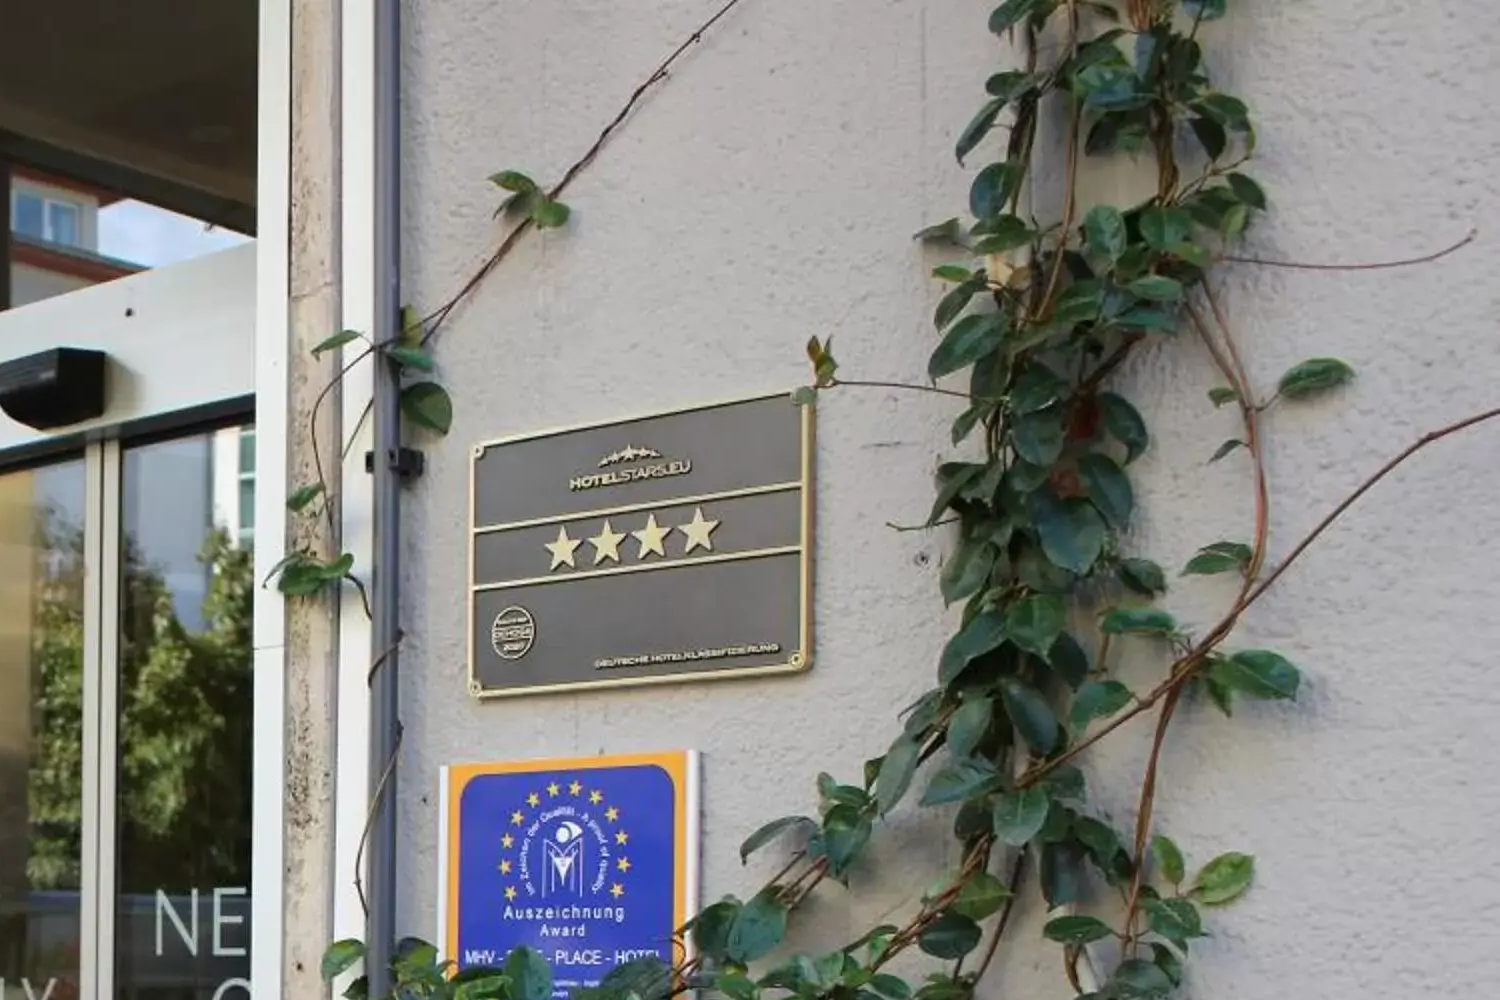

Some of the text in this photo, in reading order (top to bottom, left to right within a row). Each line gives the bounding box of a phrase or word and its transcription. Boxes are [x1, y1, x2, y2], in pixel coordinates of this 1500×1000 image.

[155, 886, 247, 957] NE
[503, 904, 625, 923] Auszeichnung
[540, 923, 586, 937] Award
[465, 949, 496, 965] MHV
[555, 949, 602, 965] PLACE
